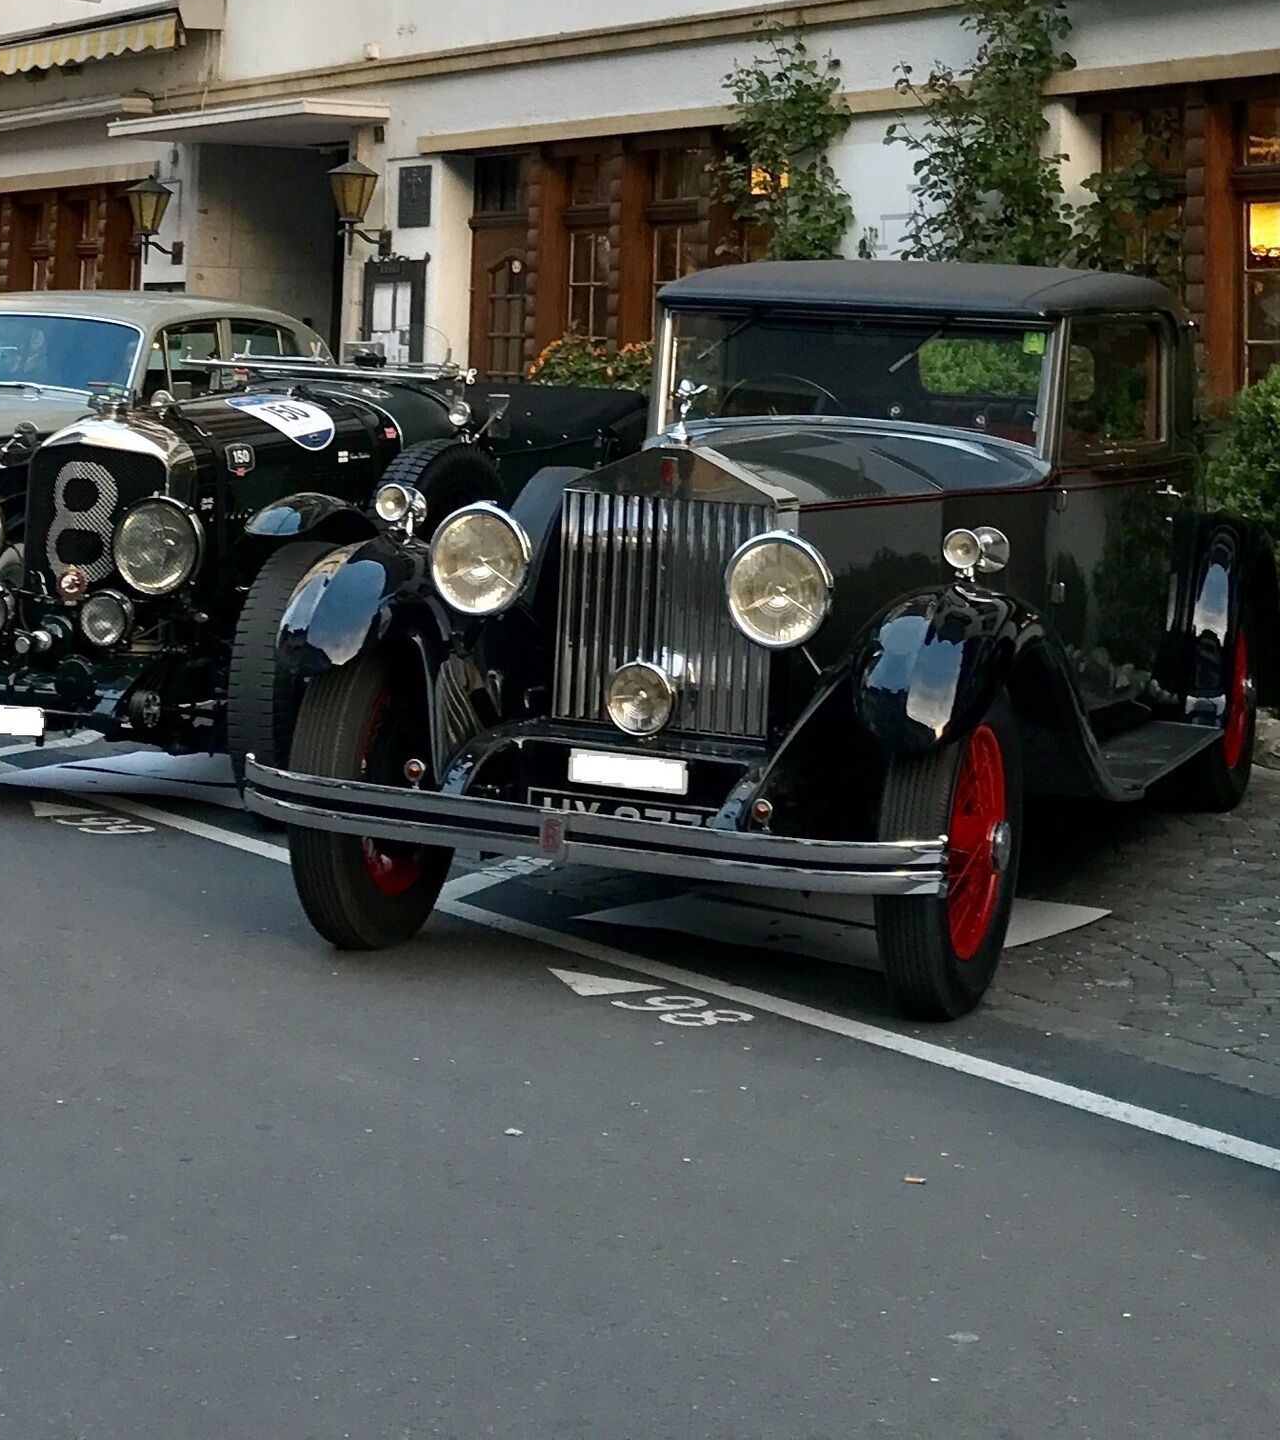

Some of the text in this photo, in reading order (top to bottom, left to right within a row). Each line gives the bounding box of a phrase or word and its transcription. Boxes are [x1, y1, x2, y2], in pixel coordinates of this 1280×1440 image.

[259, 404, 311, 423] 150
[232, 448, 251, 464] 150
[46, 460, 118, 583] 8
[54, 816, 157, 835] 99
[610, 995, 756, 1027] 98
